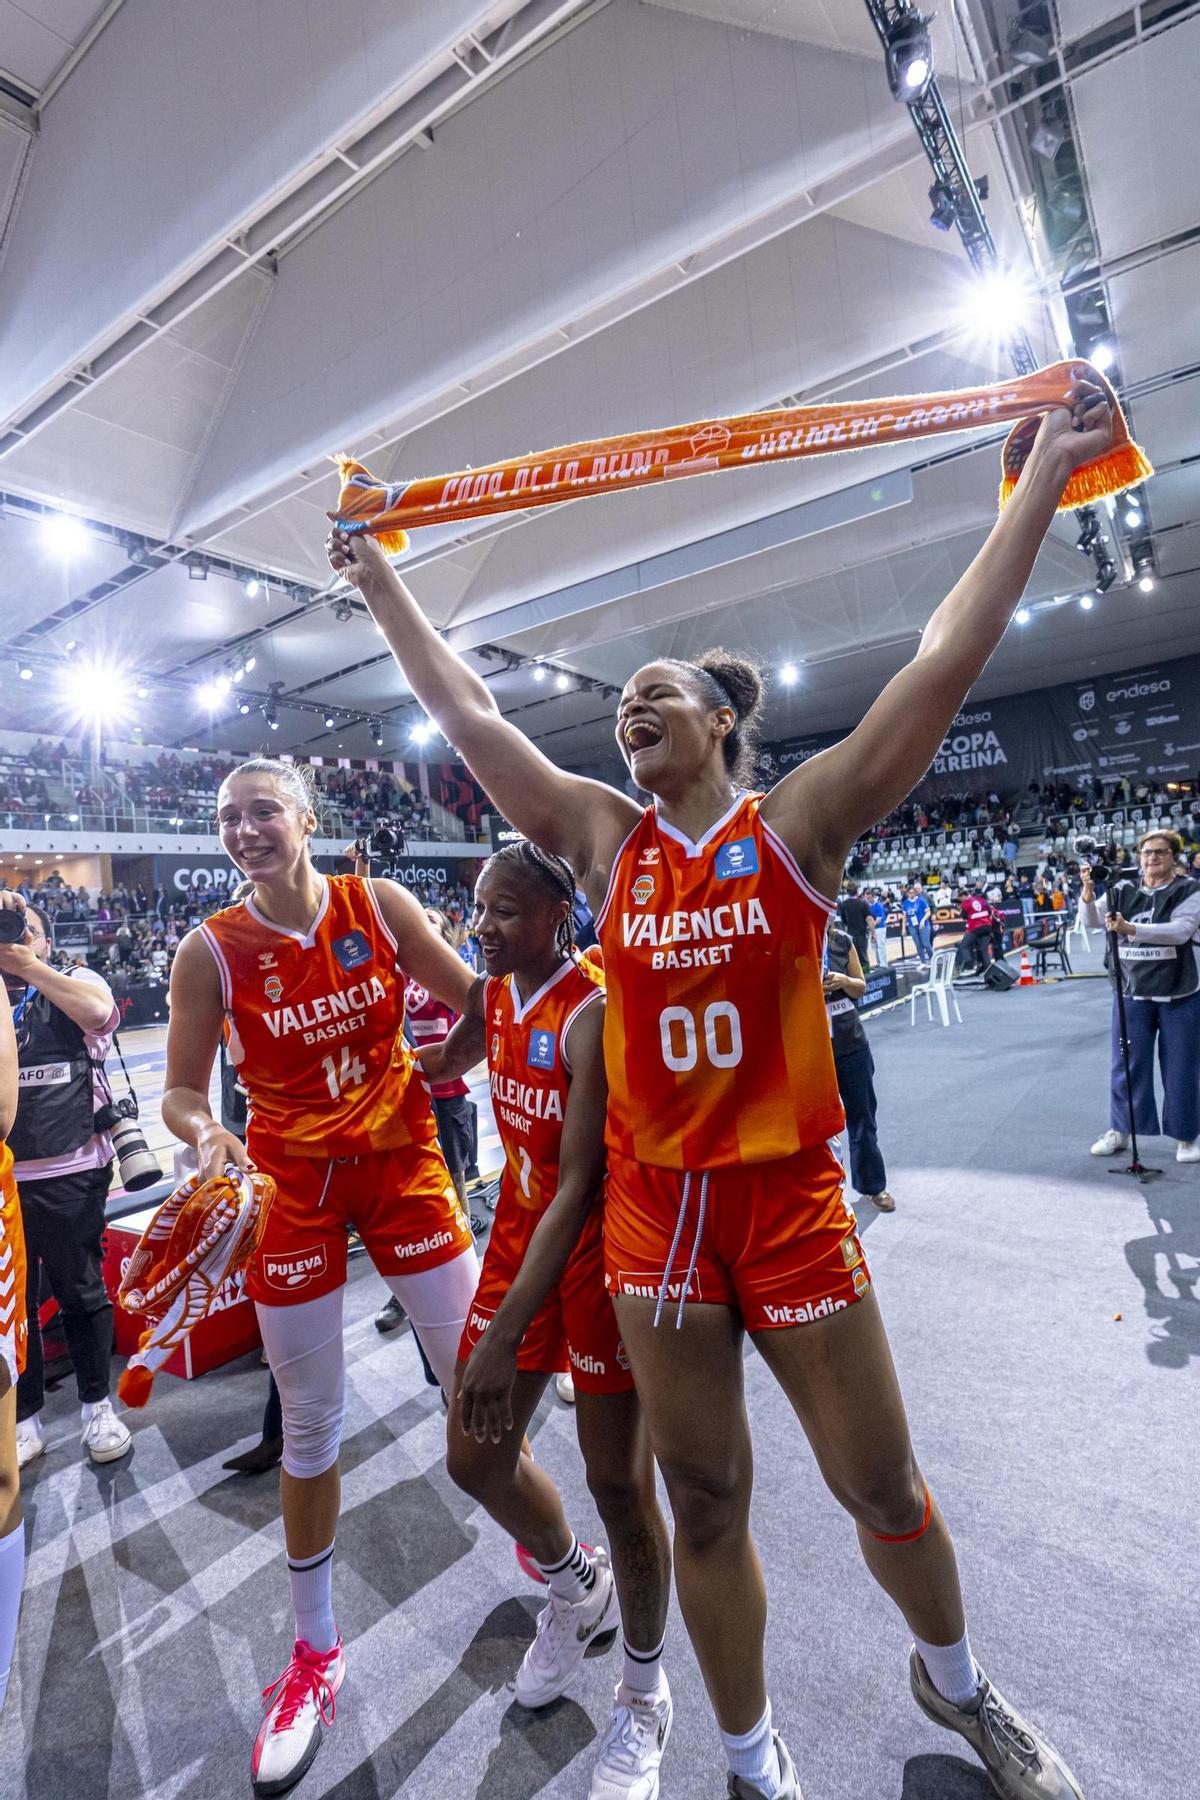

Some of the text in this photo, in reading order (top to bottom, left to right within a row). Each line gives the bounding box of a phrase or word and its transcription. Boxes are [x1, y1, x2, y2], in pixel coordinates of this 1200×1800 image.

[1106, 680, 1171, 702] endesa
[954, 711, 992, 726] desa
[779, 748, 825, 763] endes
[939, 730, 1000, 756] COPA
[948, 747, 1008, 772] REINA
[173, 868, 242, 891] COPA
[622, 898, 771, 948] VALENCIA
[651, 943, 733, 970] BASKET
[262, 976, 387, 1039] VALENCIA
[303, 1013, 367, 1046] BASKET
[659, 1001, 743, 1072] 00
[321, 1046, 366, 1100] 14
[500, 1105, 533, 1136] BASKET
[518, 1145, 532, 1199] 1
[394, 1230, 454, 1260] Vitaldin
[267, 1254, 324, 1277] PULEVA
[763, 1297, 848, 1324] Vitaldin
